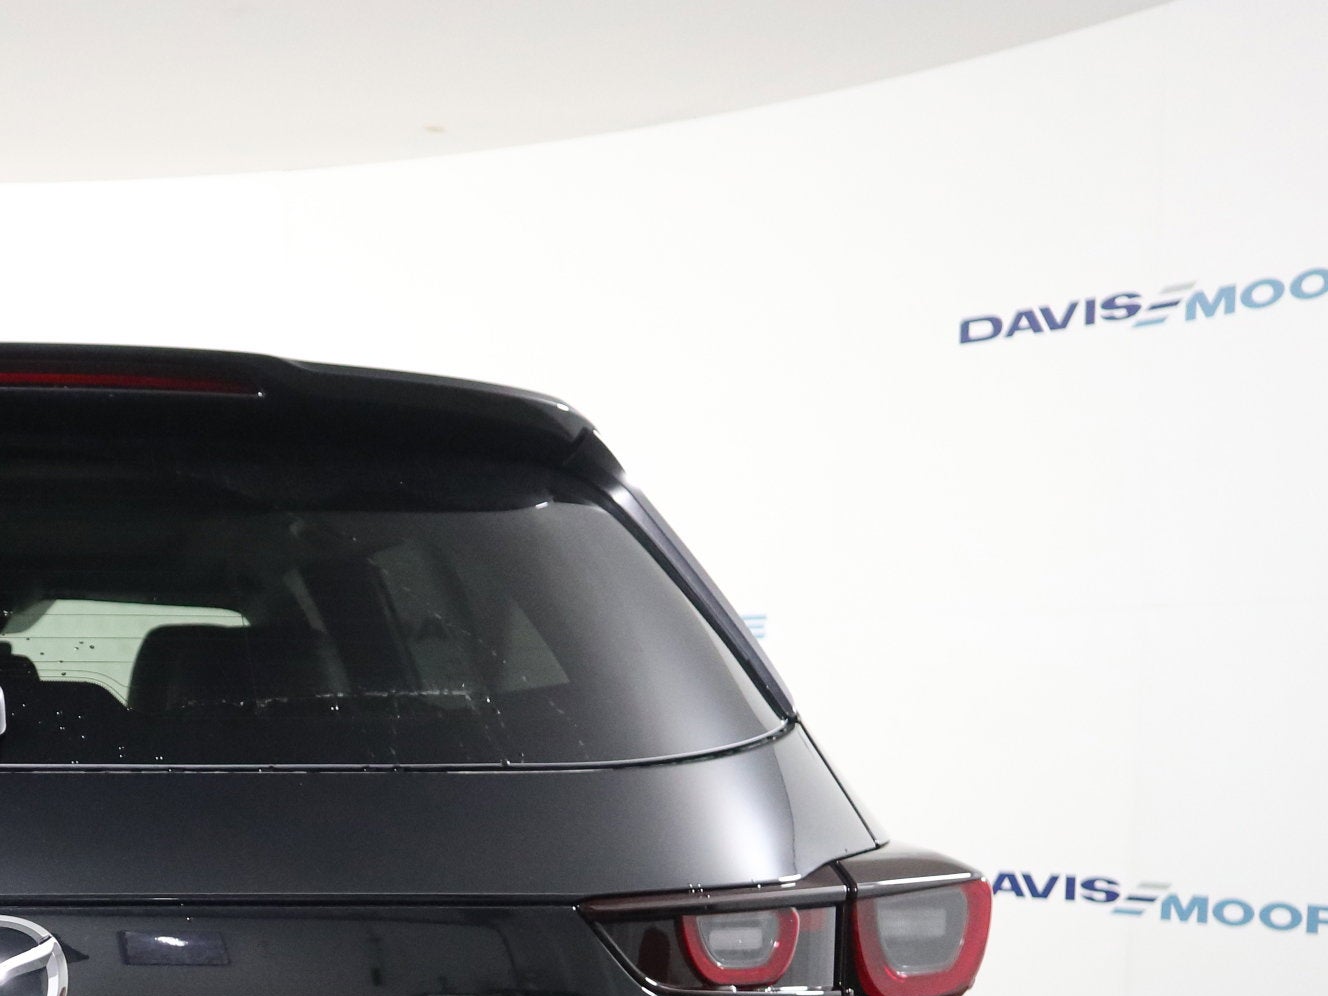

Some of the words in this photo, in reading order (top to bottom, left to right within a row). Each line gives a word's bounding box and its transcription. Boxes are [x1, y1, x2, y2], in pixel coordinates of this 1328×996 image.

[960, 291, 1142, 344] DAVIS
[1184, 268, 1328, 321] MOO
[992, 872, 1120, 903] AVIS
